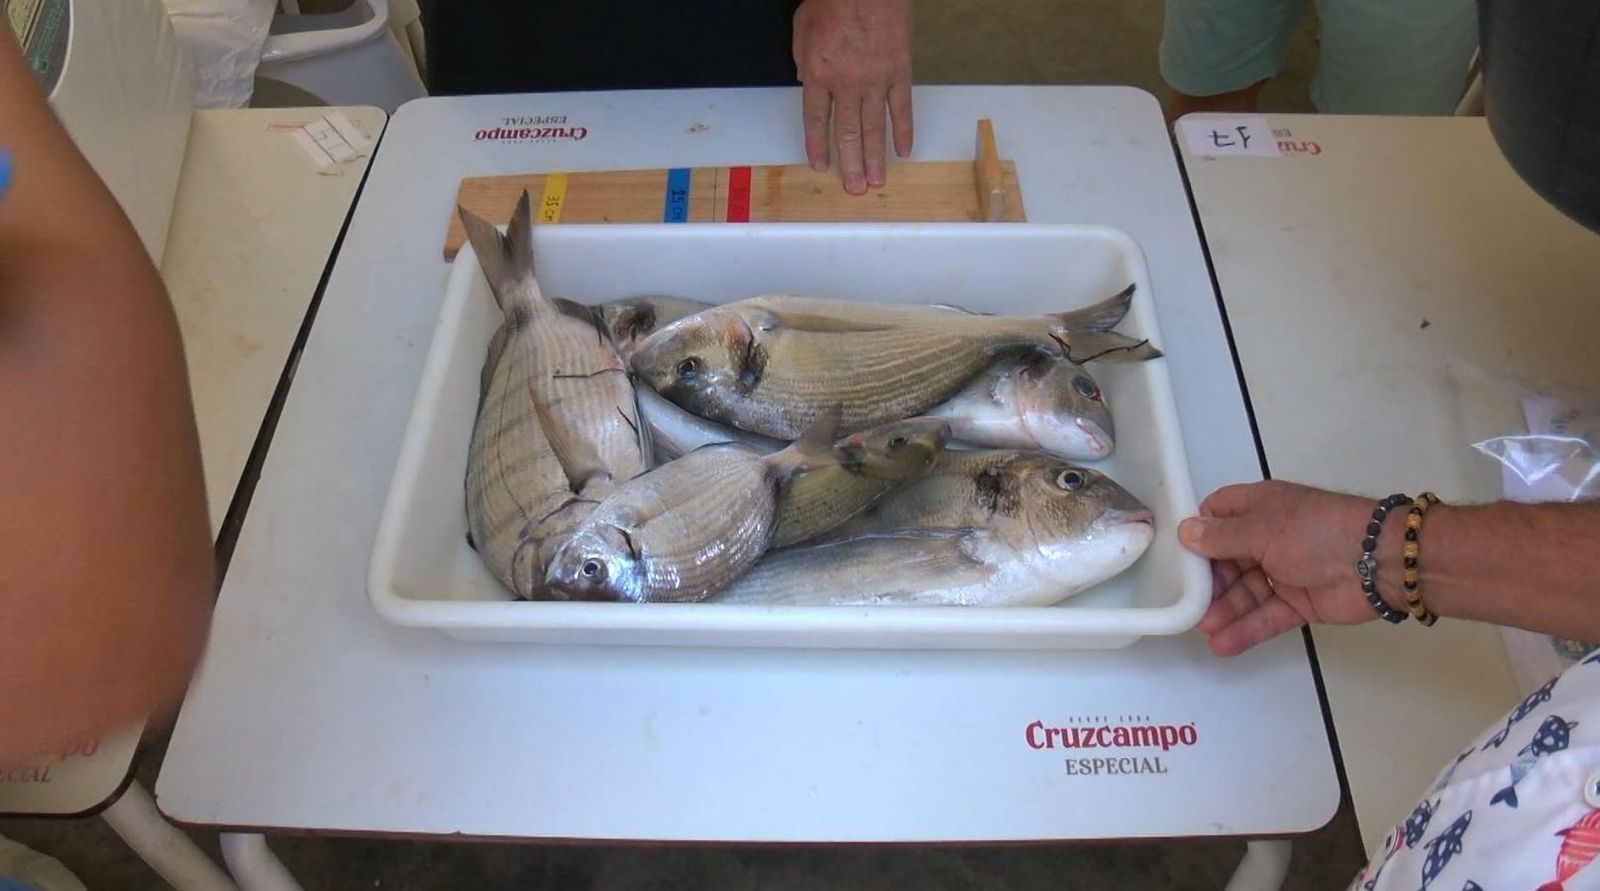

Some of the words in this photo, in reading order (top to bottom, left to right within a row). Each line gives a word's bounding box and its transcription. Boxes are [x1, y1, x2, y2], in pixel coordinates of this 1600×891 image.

[502, 115, 567, 126] ESPECIAL
[474, 127, 588, 141] Cruzcampo
[1206, 126, 1251, 149] 17
[1025, 720, 1197, 751] Cruzcampo
[1066, 757, 1167, 775] ESPECIAL
